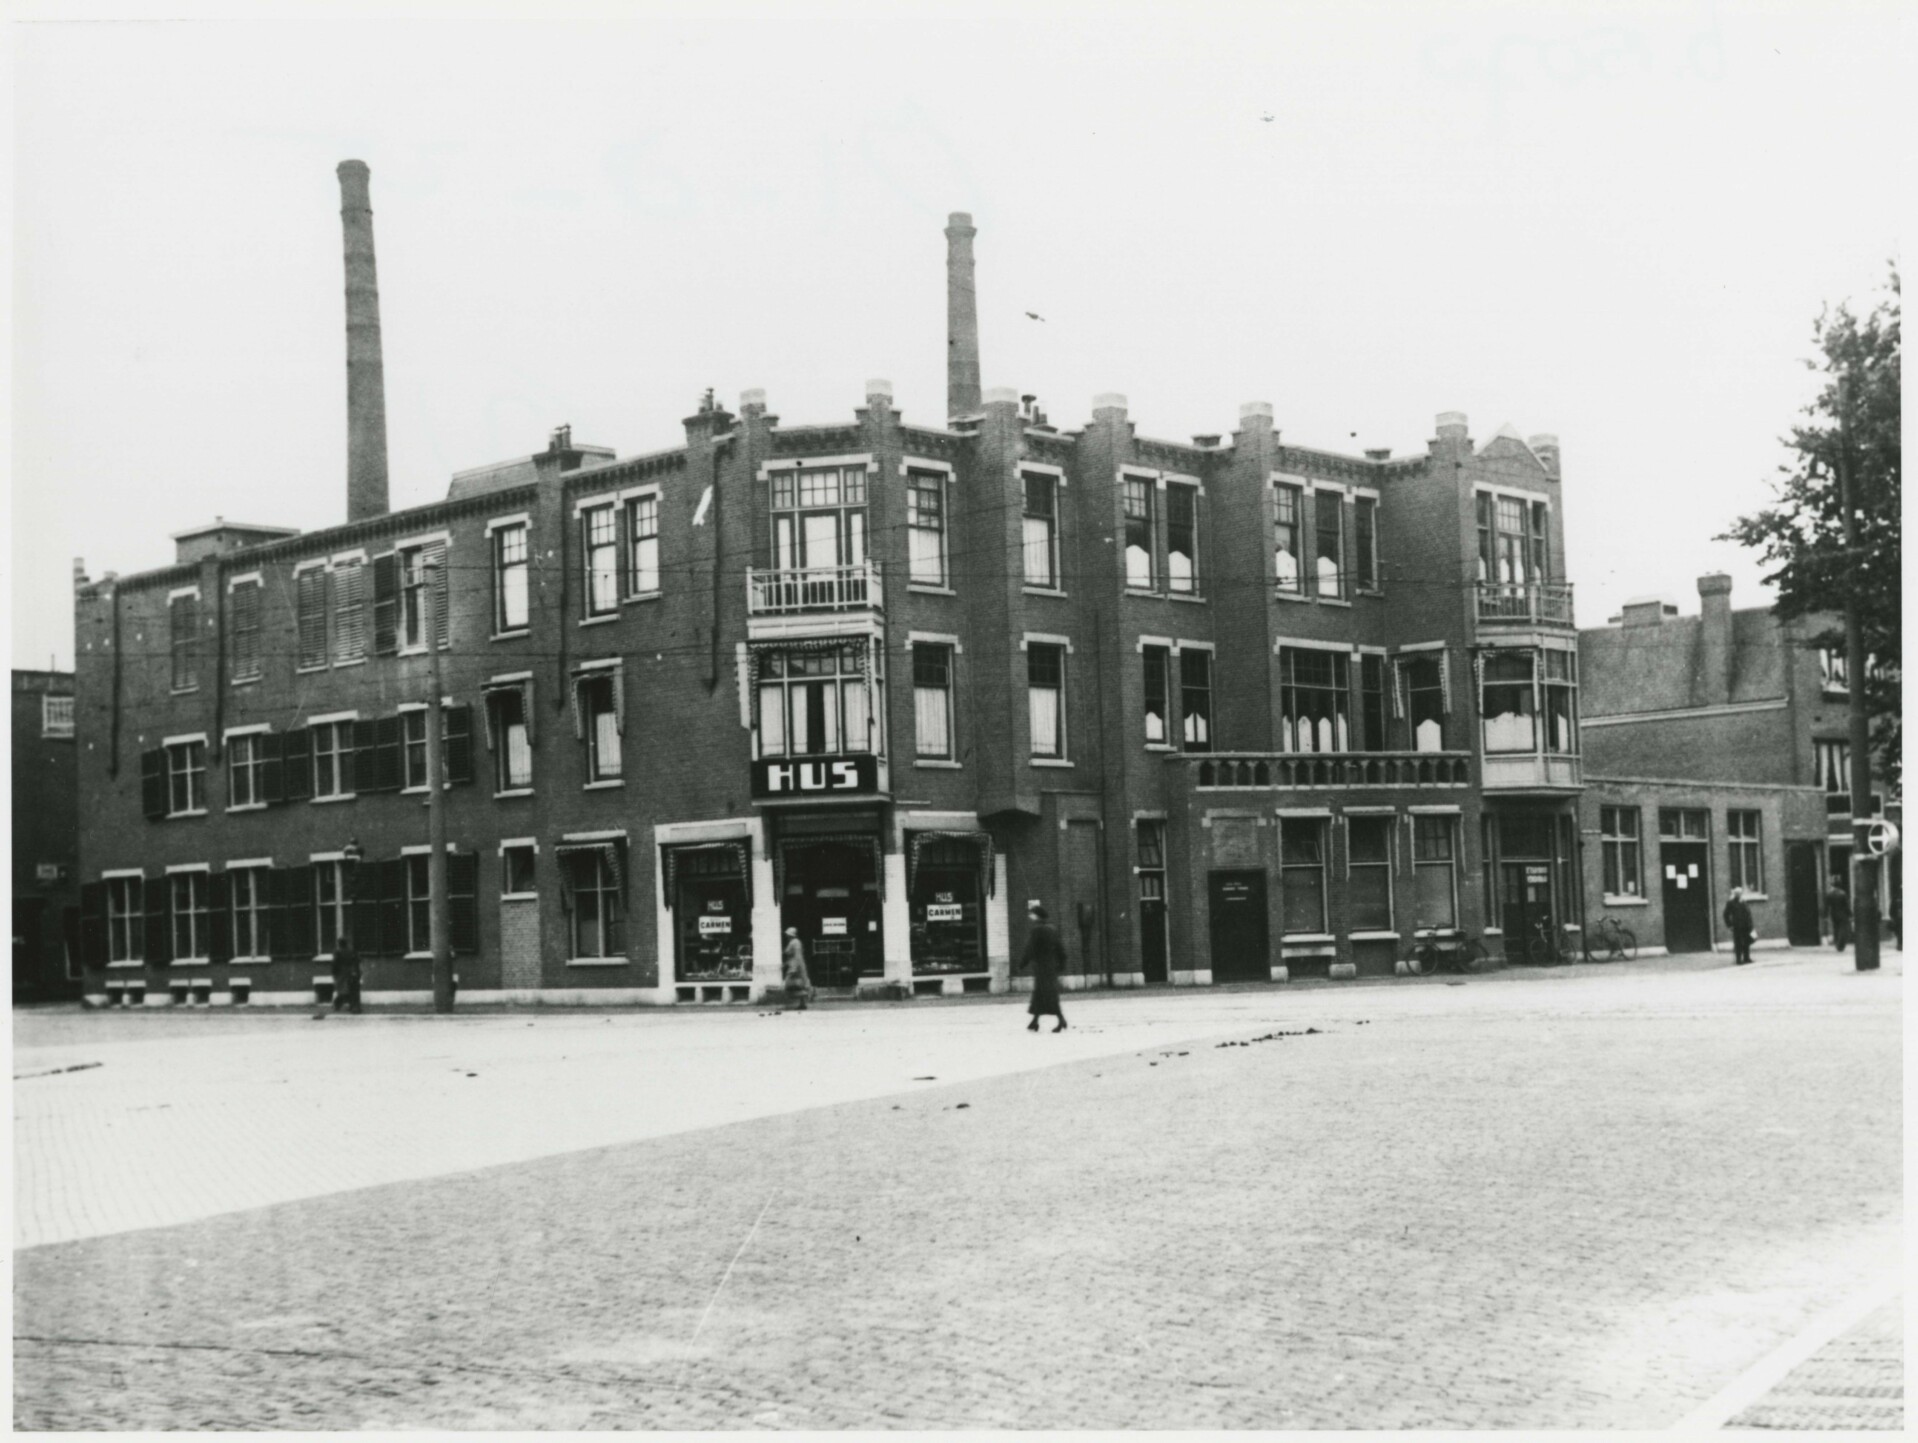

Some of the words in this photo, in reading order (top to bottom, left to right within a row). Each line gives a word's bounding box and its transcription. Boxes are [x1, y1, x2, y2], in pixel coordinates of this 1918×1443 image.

[768, 762, 858, 791] HUS
[936, 892, 953, 903] HUS
[707, 900, 723, 911] HUS
[929, 909, 961, 917] CARMEN
[700, 921, 731, 929] CARMEN
